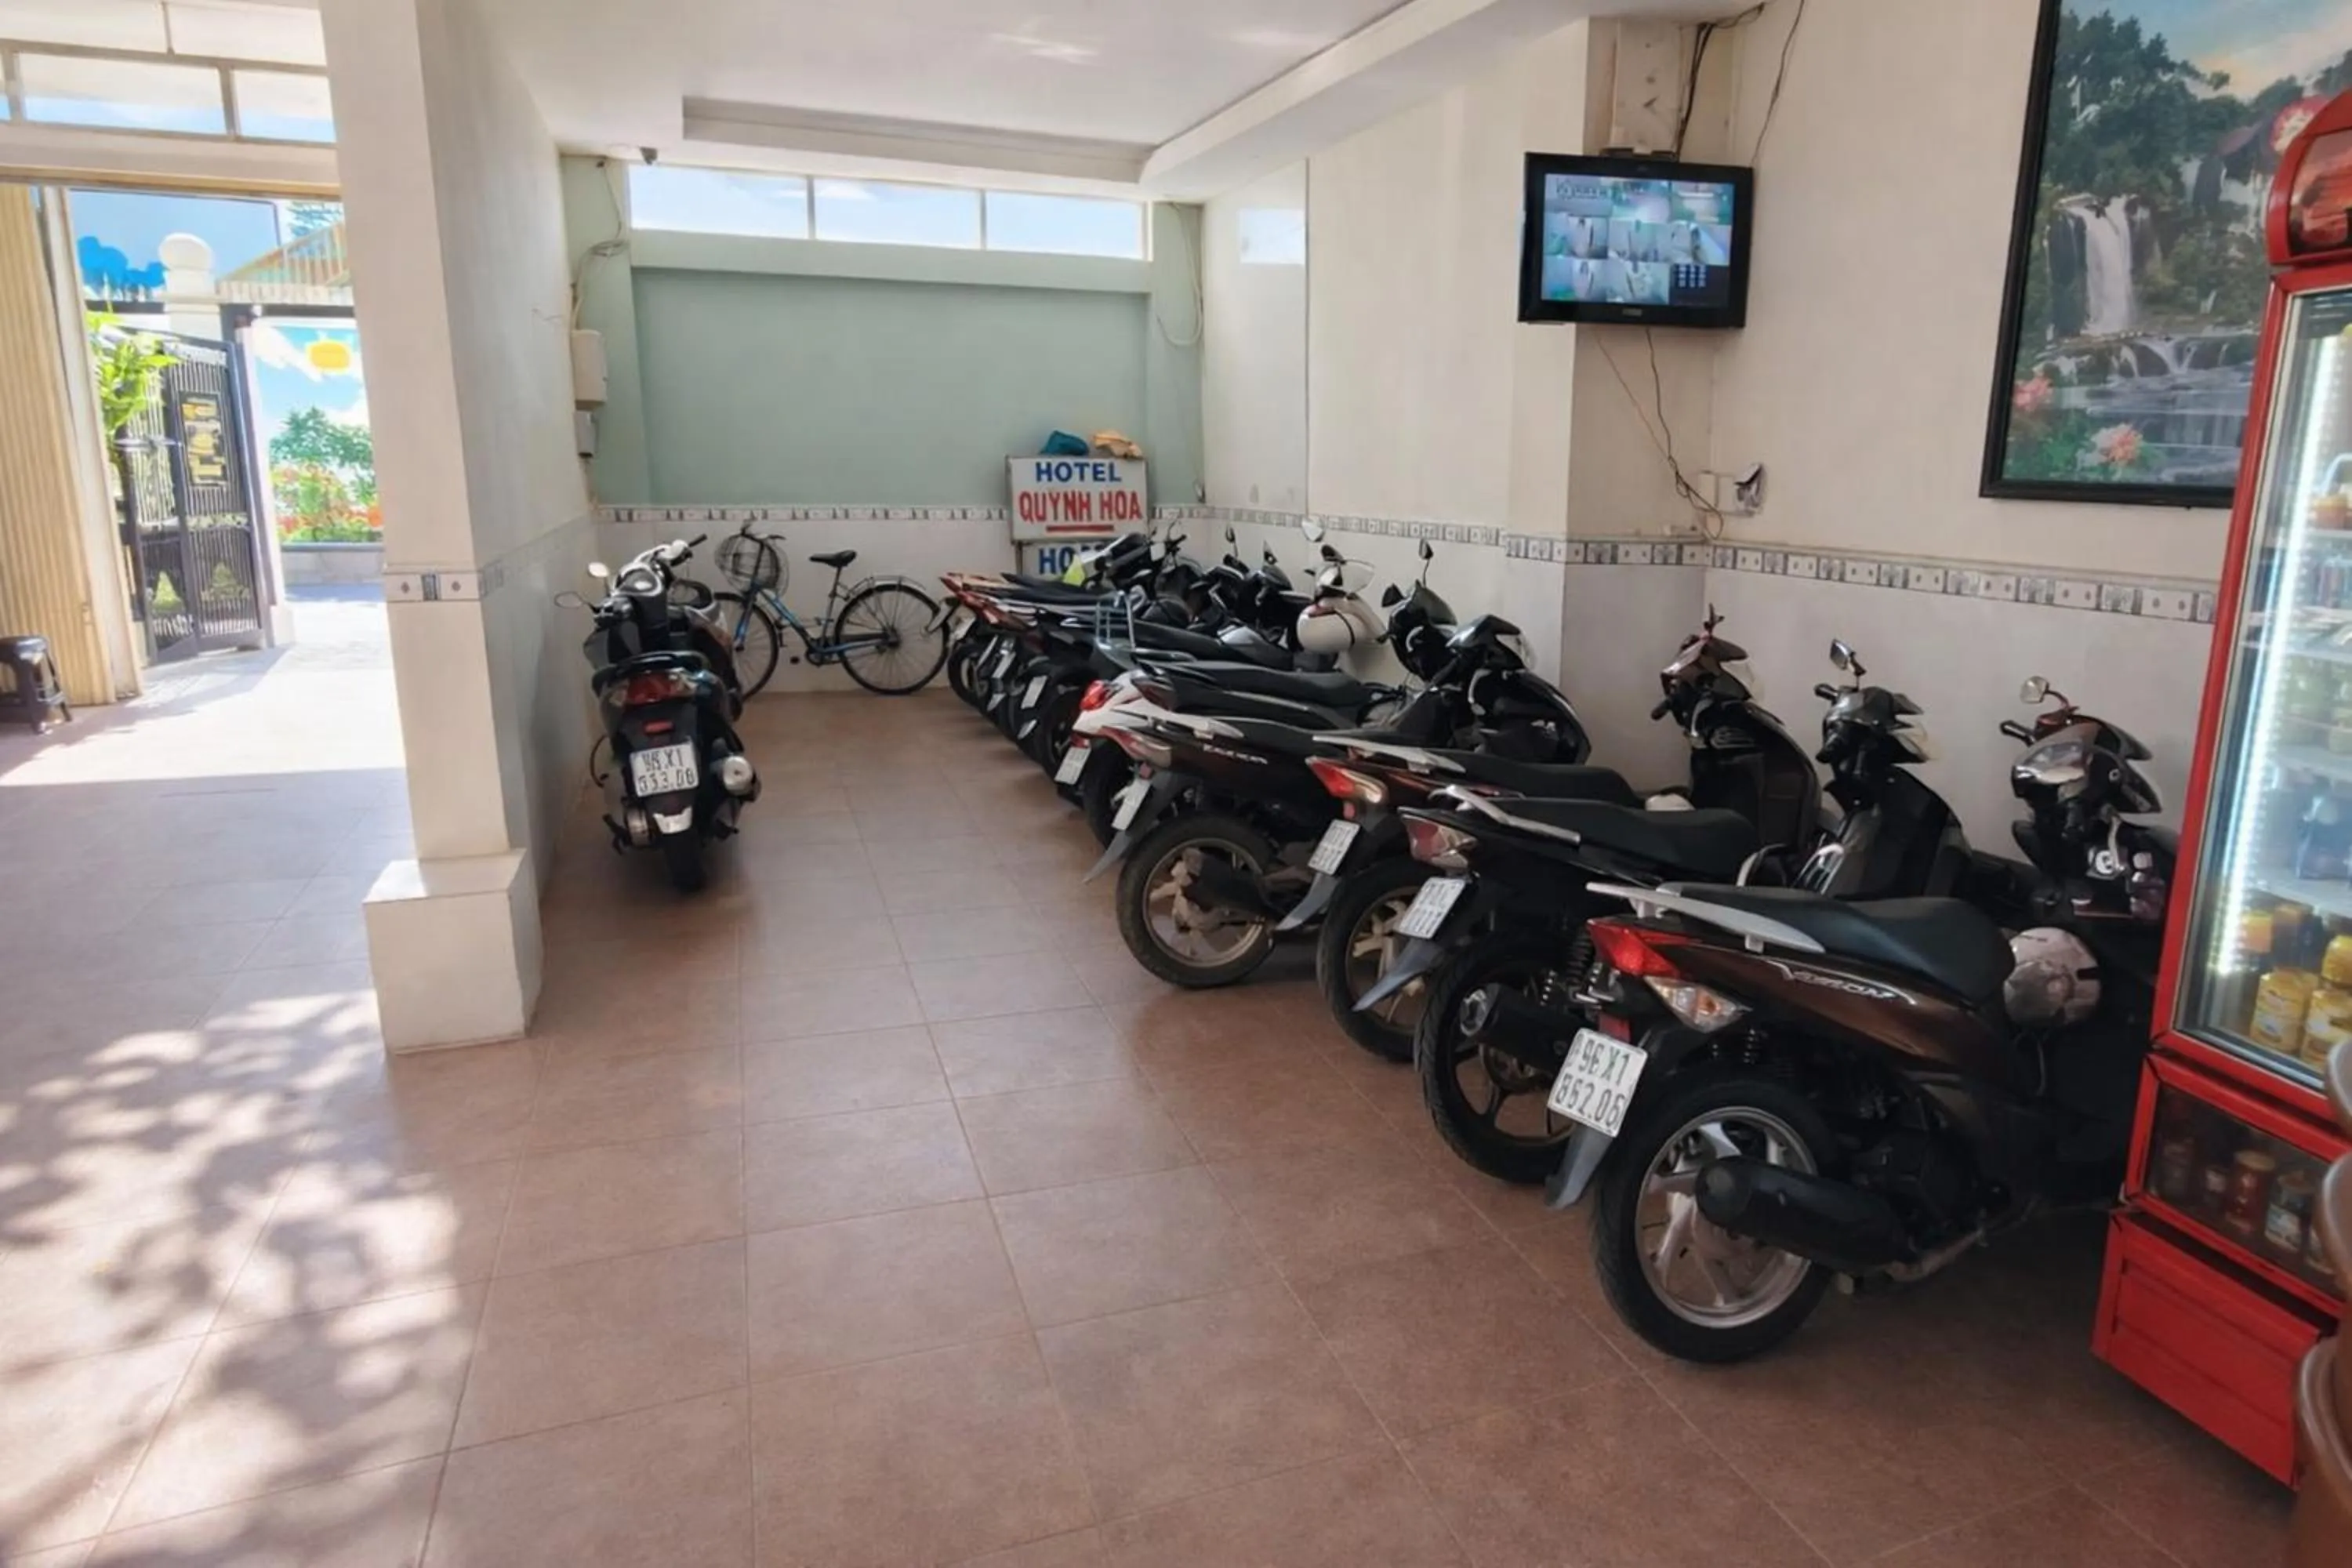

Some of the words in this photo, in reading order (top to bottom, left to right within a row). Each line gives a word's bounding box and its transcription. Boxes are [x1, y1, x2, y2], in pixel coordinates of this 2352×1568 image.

[1036, 461, 1122, 483] HOTEL
[1018, 490, 1091, 524] QUYNH
[1099, 490, 1142, 521] HOA
